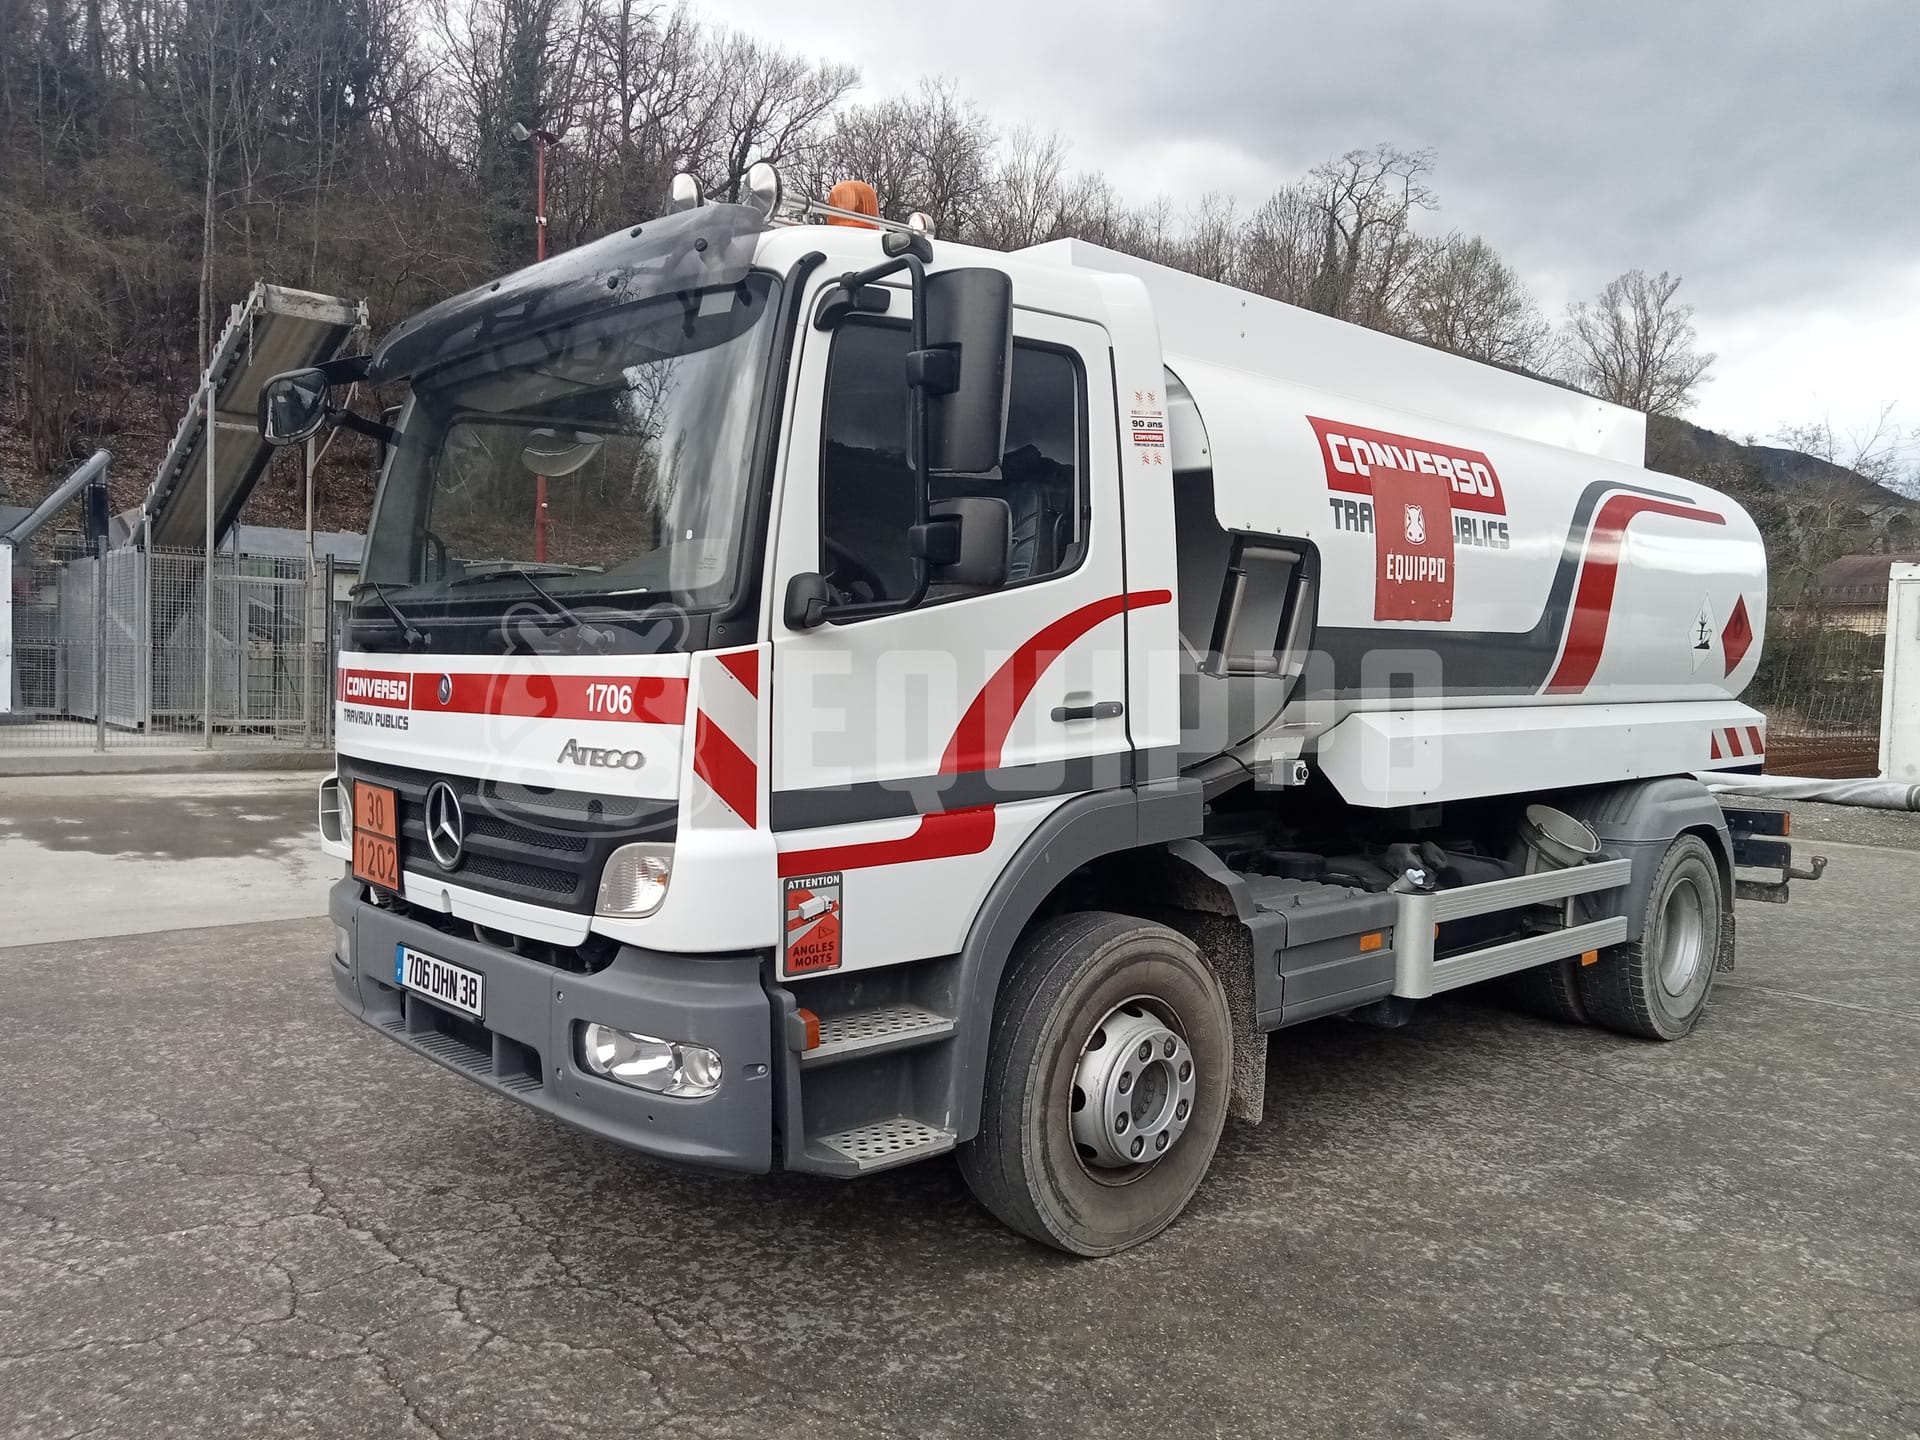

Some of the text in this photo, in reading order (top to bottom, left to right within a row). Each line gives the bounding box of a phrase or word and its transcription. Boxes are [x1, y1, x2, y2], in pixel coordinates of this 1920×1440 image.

[1132, 420, 1144, 428] 90
[1326, 433, 1496, 498] CONVERSO
[1453, 515, 1510, 550] UBLICS
[1386, 553, 1446, 584] EQUIPPO
[346, 676, 407, 701] CONVERSO
[586, 683, 632, 715] 1706
[344, 708, 409, 730] TRAVAUX PUBLICS
[367, 791, 384, 831] 30
[359, 836, 396, 883] 1202
[787, 874, 840, 890] ATTENTION
[793, 941, 835, 957] ANGLES
[795, 953, 832, 968] MORTS
[407, 953, 431, 990] 706
[432, 964, 458, 1002] DHN
[460, 974, 478, 1009] 38
